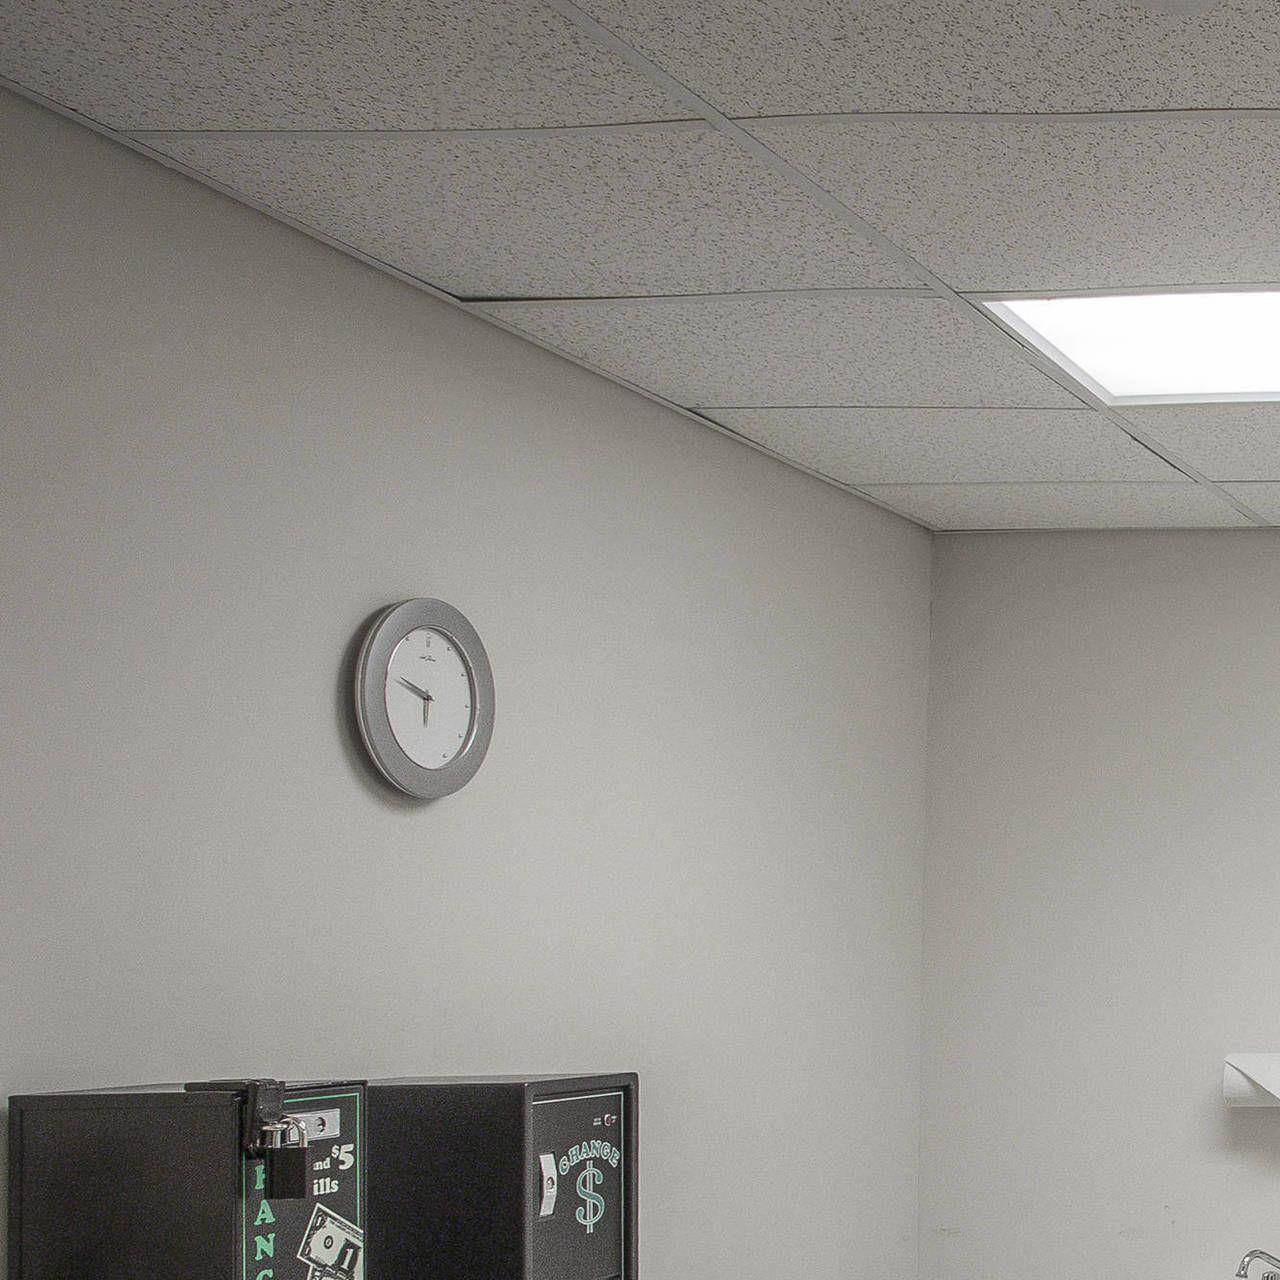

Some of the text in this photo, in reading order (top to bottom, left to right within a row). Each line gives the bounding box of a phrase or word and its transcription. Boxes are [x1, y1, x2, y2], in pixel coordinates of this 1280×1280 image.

[313, 1157, 331, 1171] nd
[559, 1140, 621, 1175] CHANGE
[312, 1176, 340, 1195] ills
